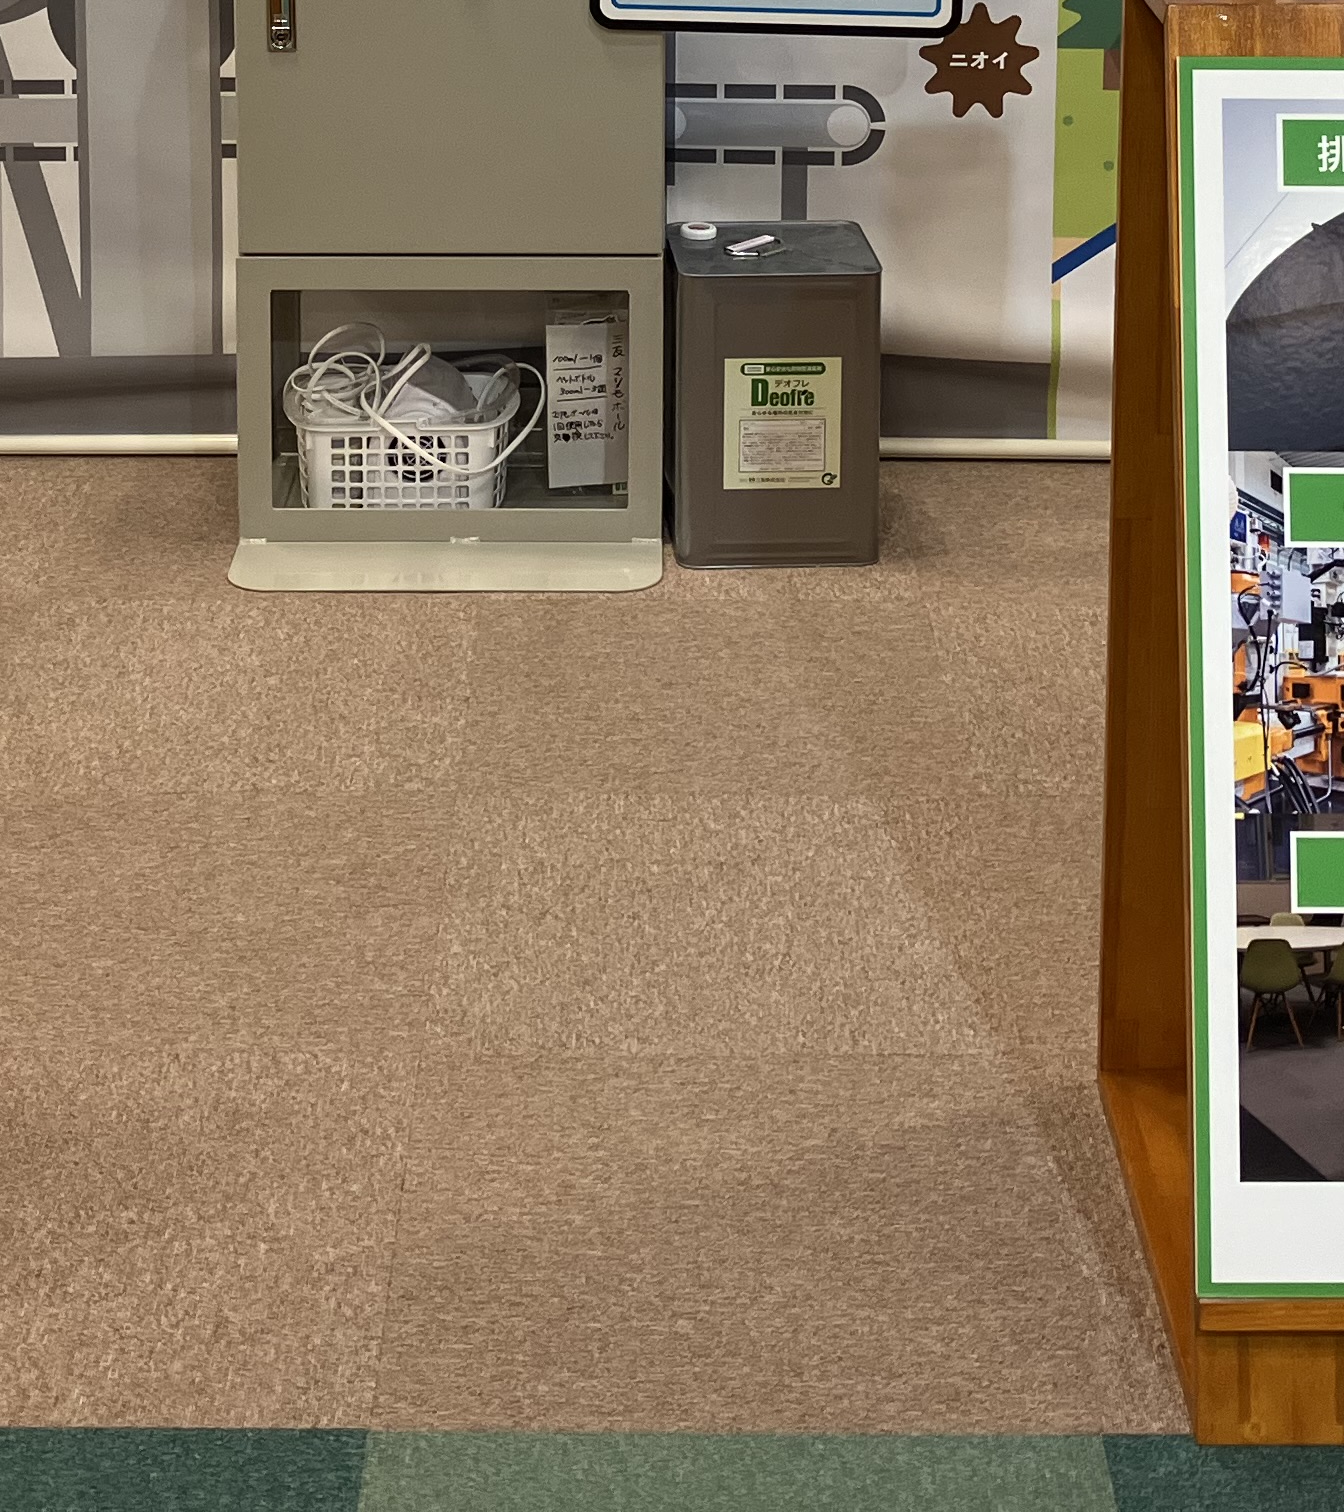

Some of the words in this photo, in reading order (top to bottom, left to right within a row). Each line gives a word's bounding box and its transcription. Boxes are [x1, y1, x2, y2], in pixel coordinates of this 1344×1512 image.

[948, 50, 1010, 71] ニオイ
[750, 378, 815, 407] Deofre
[774, 379, 810, 388] デオフレ
